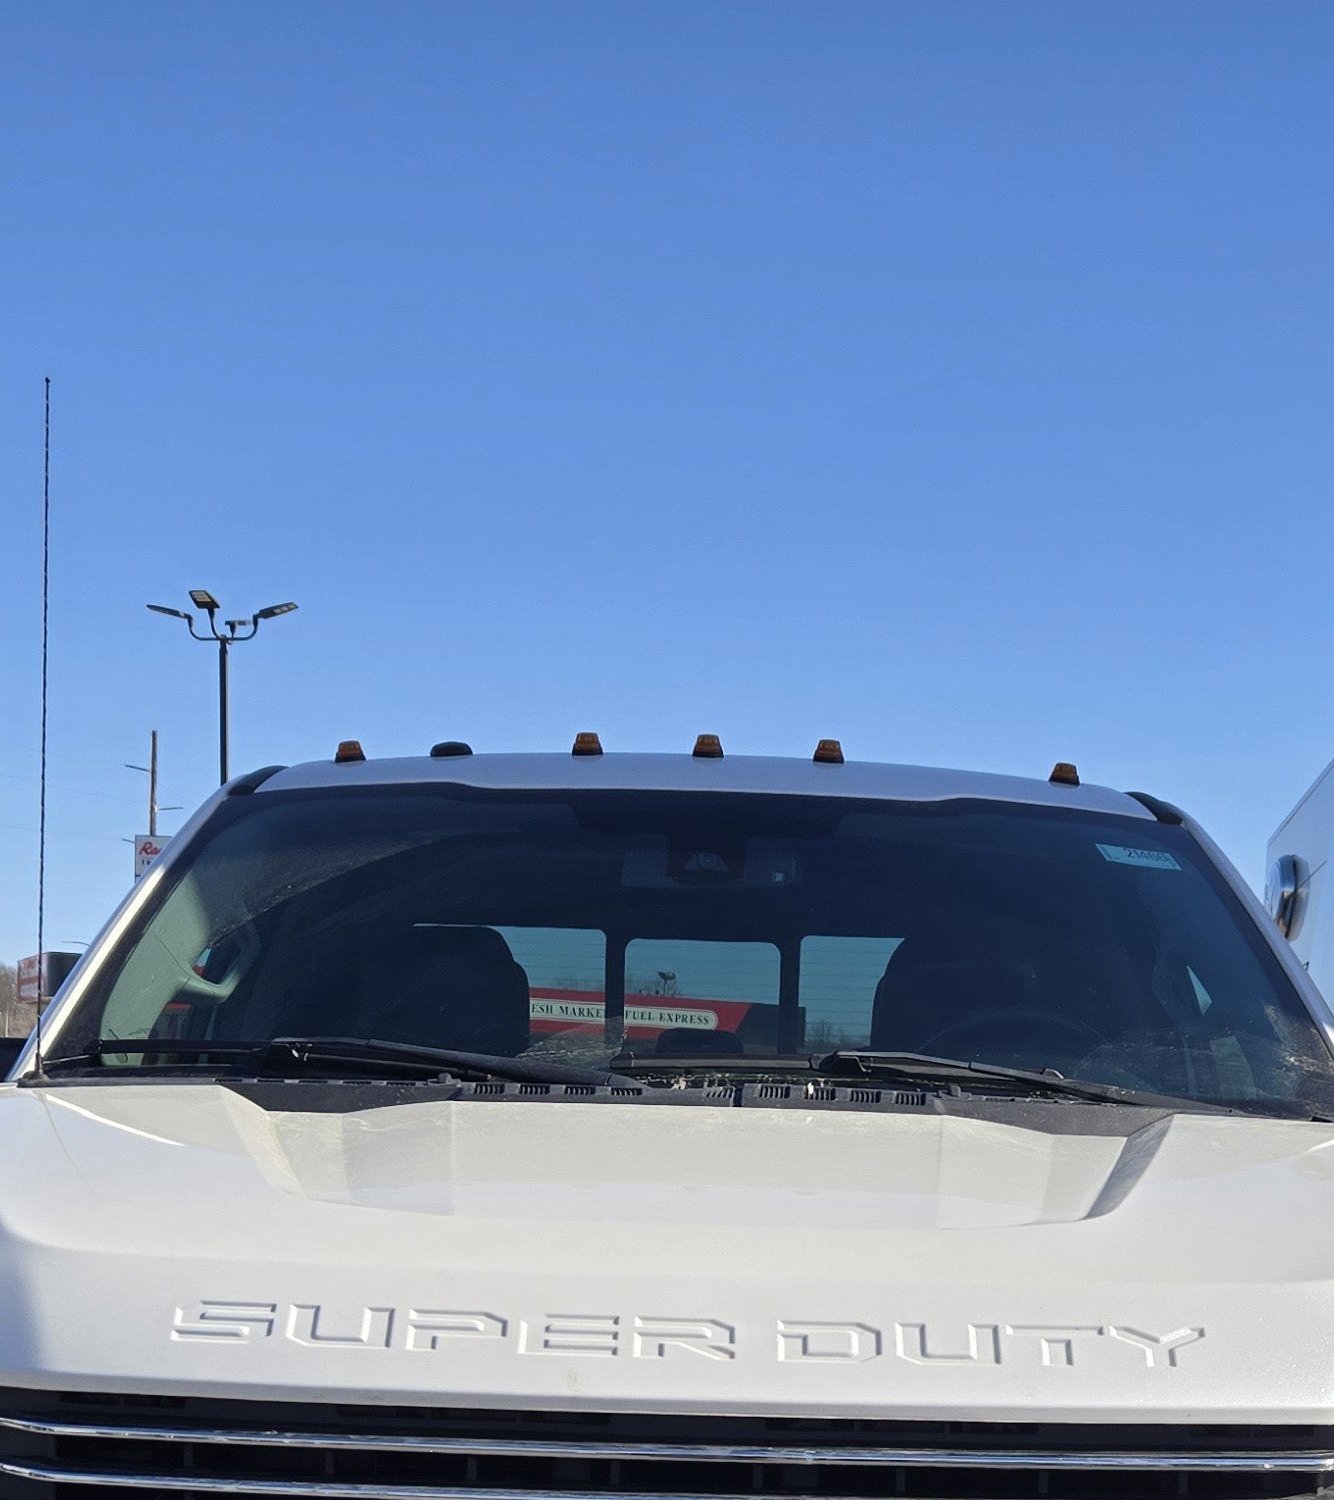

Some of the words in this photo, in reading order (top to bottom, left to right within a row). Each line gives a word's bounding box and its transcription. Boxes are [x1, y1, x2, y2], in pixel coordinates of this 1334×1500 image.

[531, 1003, 553, 1015] ESH
[559, 1005, 606, 1018] MARKE
[625, 1010, 655, 1021] FUEL
[659, 1012, 709, 1025] EXPRESS
[169, 1299, 736, 1362] SUPER
[775, 1317, 1205, 1368] DUTY
